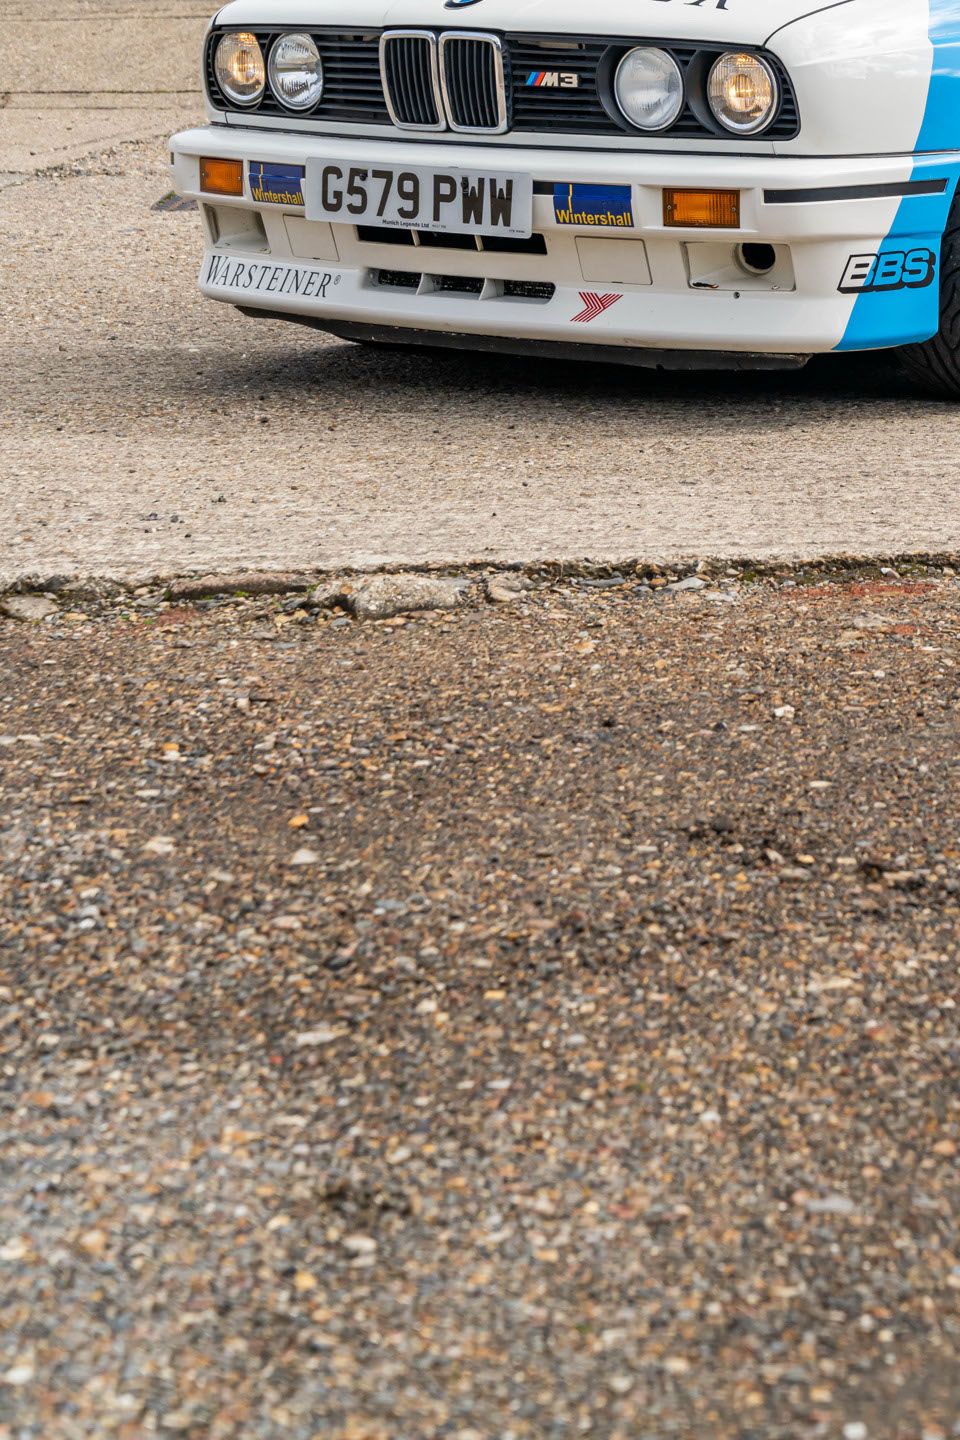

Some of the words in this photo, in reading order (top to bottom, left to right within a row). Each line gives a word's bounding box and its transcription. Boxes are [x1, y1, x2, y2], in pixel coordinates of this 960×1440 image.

[540, 72, 579, 88] M3
[251, 186, 305, 206] Wintershall
[322, 165, 420, 220] G579
[433, 174, 514, 228] PWW
[556, 208, 632, 227] Wintershall
[837, 247, 936, 294] BBS
